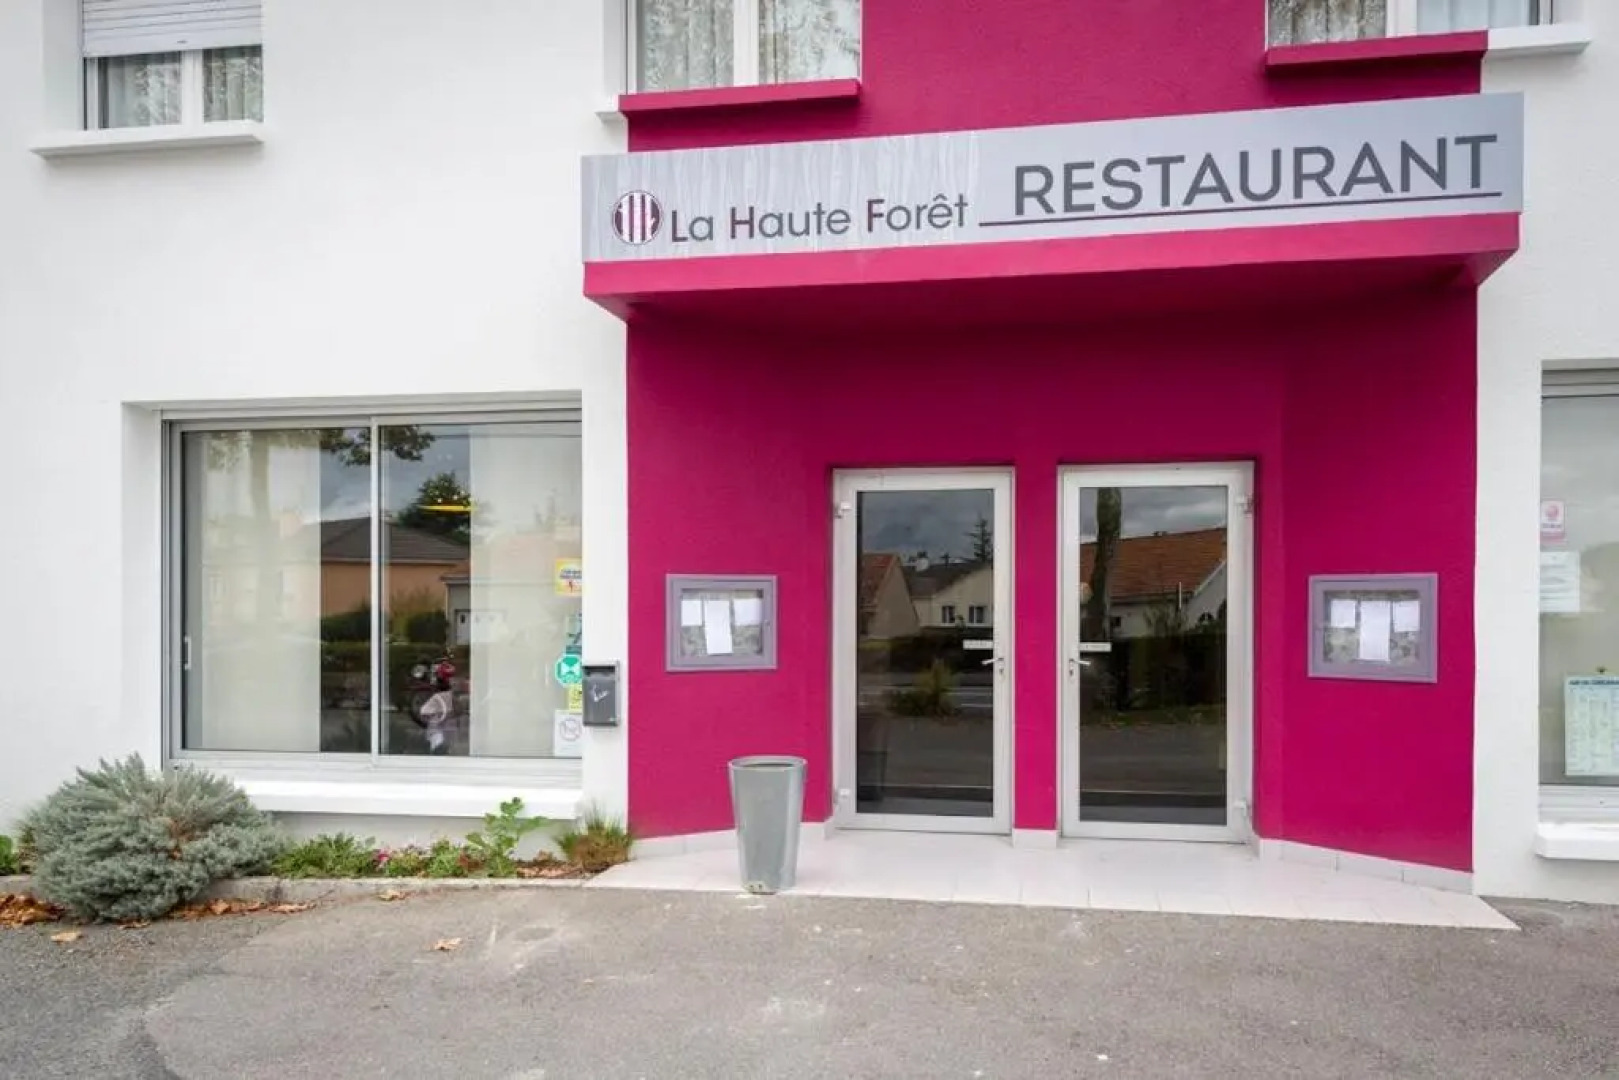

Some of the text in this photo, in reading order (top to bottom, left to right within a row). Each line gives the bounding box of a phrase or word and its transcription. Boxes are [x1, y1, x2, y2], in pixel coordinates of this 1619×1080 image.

[1014, 134, 1498, 216] RESTAURANT
[671, 193, 969, 242] La Haute Forêt
